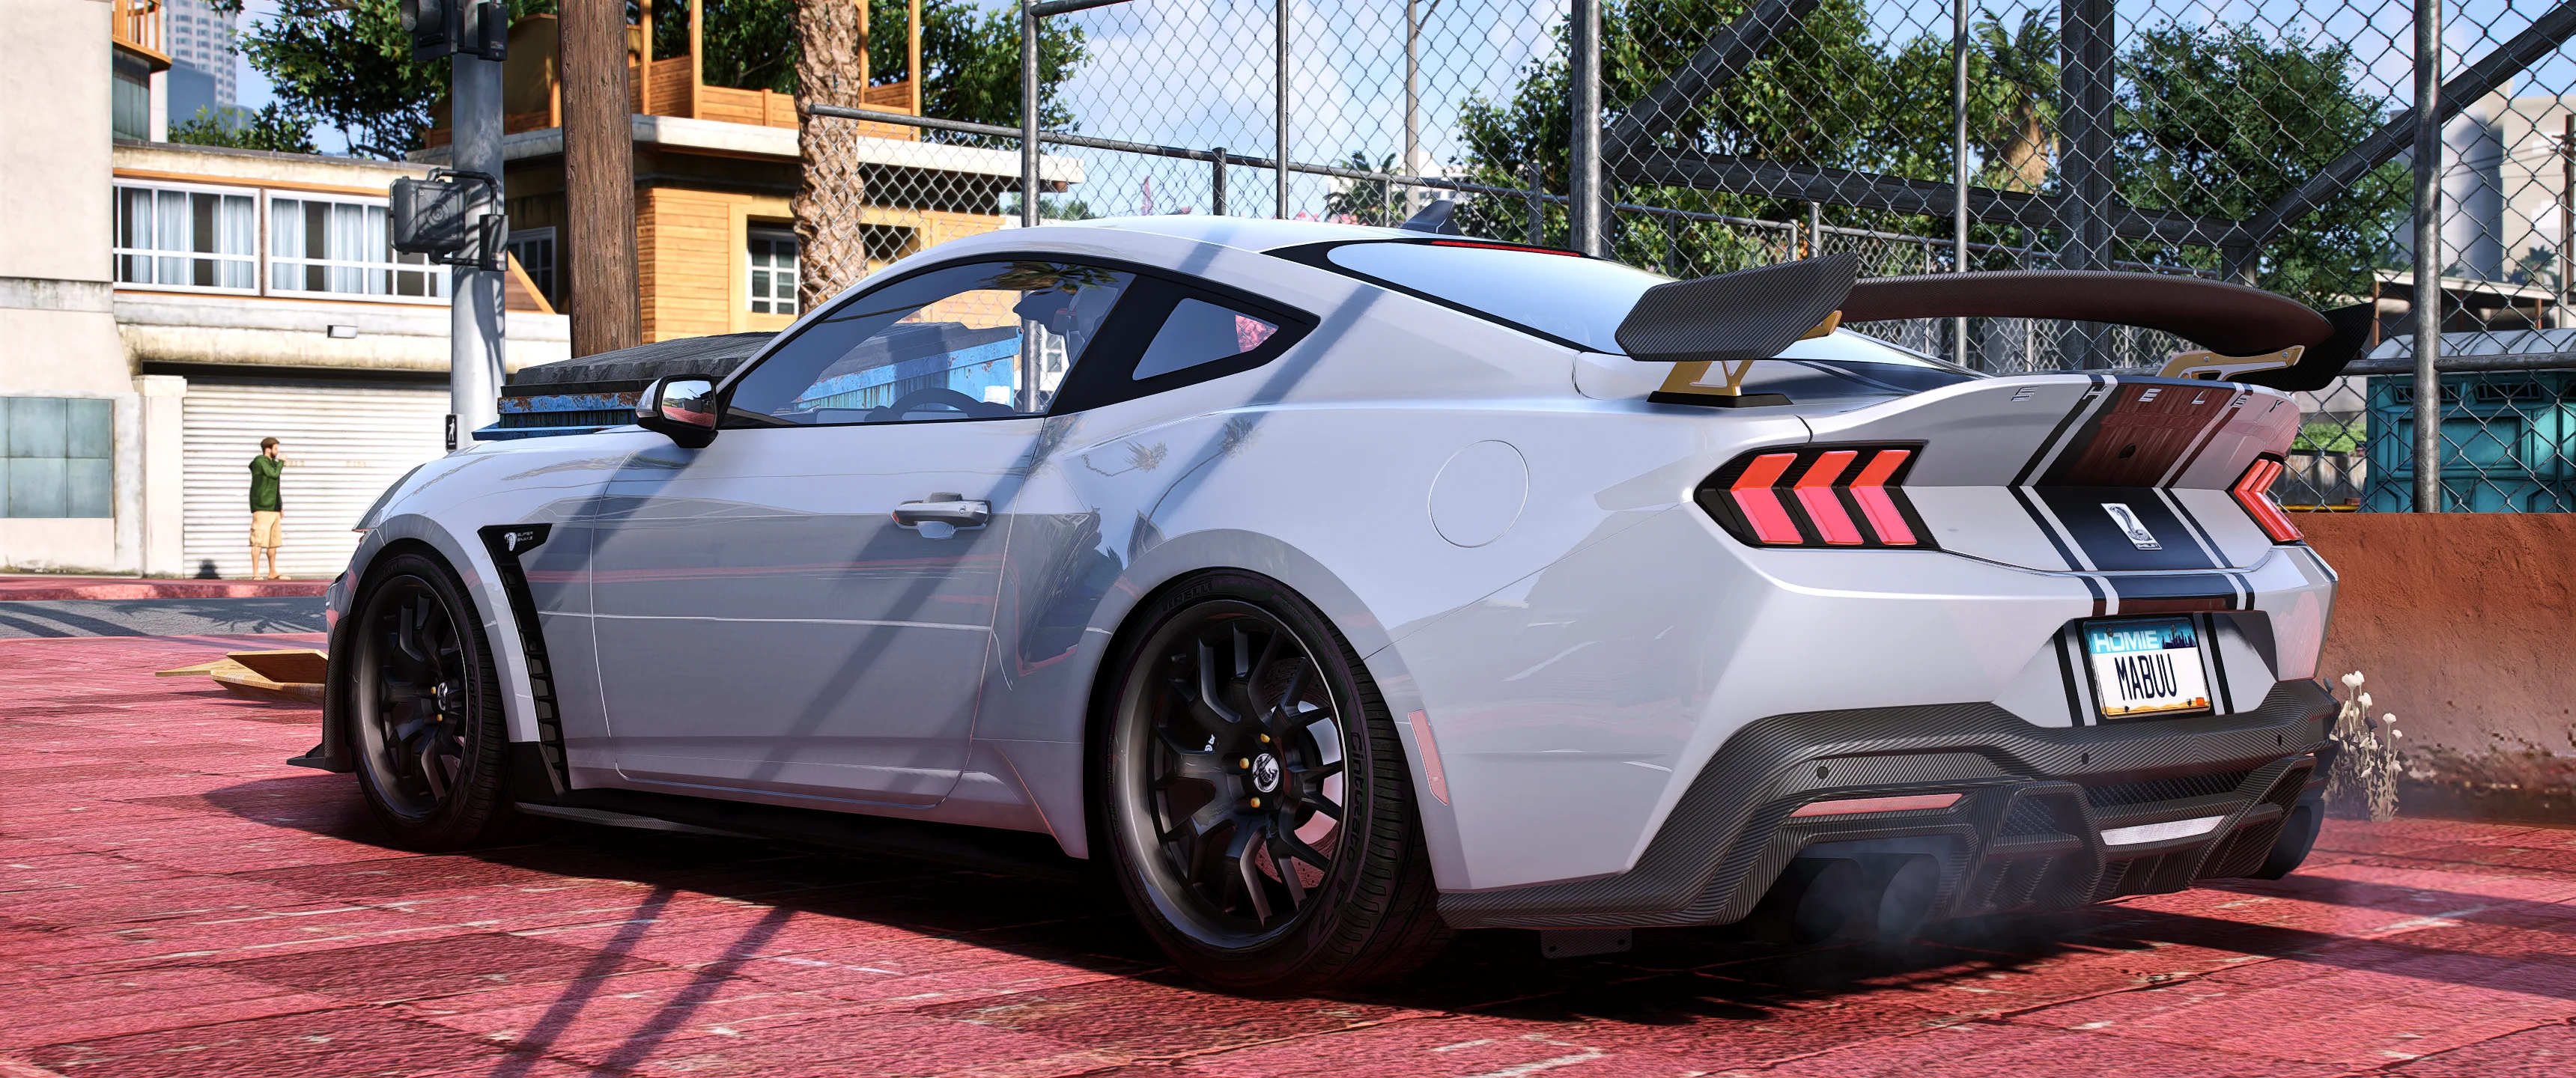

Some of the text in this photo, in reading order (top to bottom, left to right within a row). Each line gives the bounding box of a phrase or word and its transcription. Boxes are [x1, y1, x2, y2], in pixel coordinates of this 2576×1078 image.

[2011, 386, 2283, 413] SHELBY
[2093, 630, 2160, 653] HOMIE
[2114, 654, 2178, 701] MABUU
[1346, 732, 1364, 862] Cinturato
